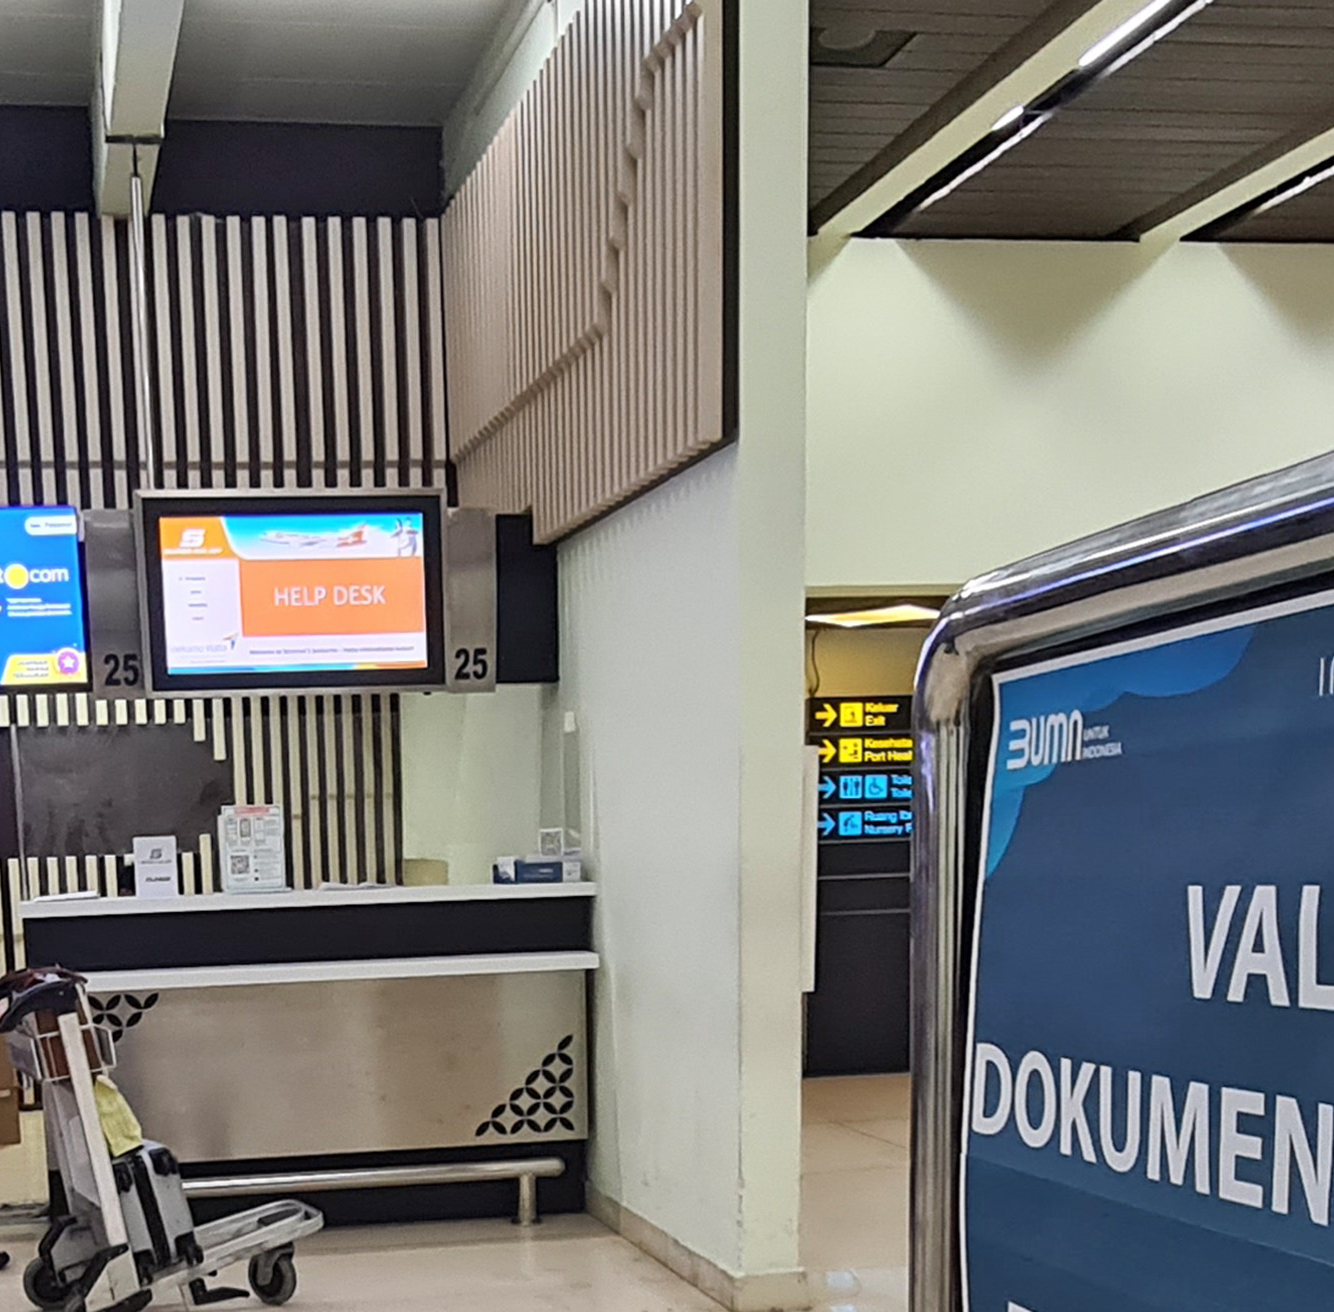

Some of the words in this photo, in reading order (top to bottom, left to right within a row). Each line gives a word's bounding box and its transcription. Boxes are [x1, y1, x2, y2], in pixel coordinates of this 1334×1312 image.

[274, 587, 327, 606] HELP
[334, 585, 386, 605] DESK
[103, 653, 140, 687] 25
[455, 648, 488, 680] 25
[970, 1041, 1334, 1227] DOKUMEN
